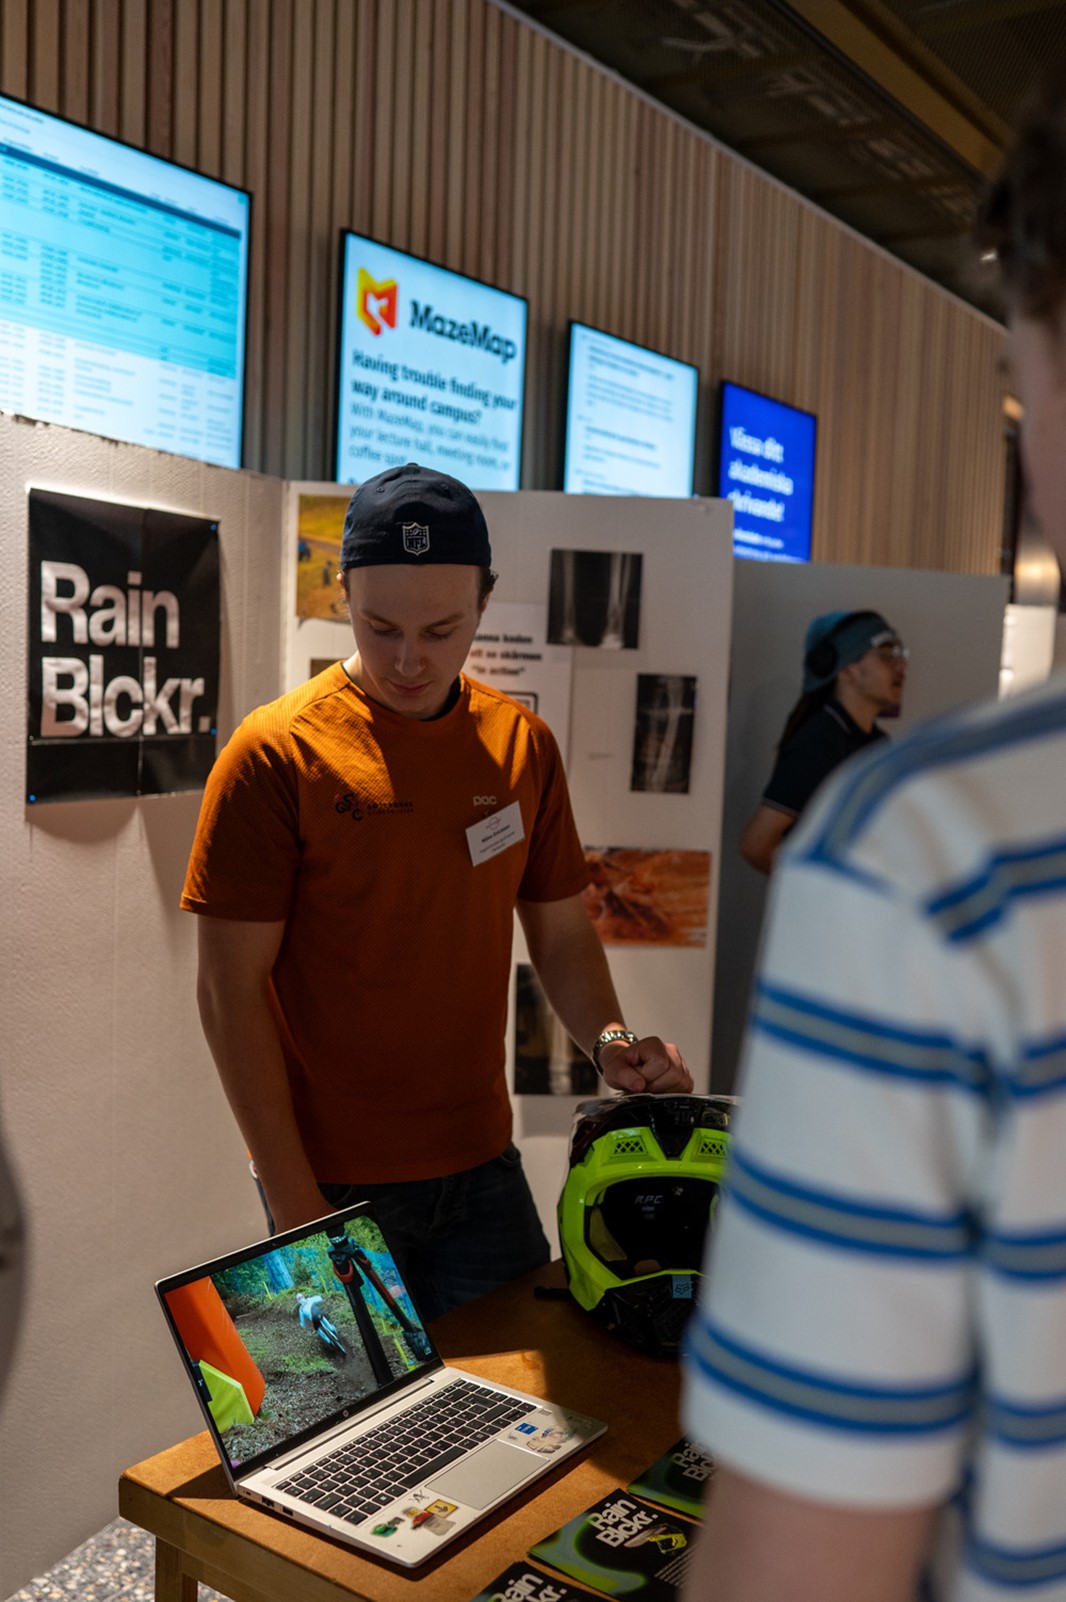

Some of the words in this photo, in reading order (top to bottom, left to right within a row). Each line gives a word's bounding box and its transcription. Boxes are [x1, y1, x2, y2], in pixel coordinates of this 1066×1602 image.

[410, 300, 517, 365] MazeMap
[351, 379, 378, 400] way
[382, 388, 427, 411] around
[430, 400, 483, 424] campus?
[352, 350, 398, 381] Having
[401, 365, 447, 390] trouble
[450, 376, 490, 406] finding
[492, 394, 516, 410] your
[40, 559, 180, 649] Rain
[39, 654, 211, 738] Blckr.
[671, 1442, 707, 1468] Rai
[585, 1499, 637, 1531] Rain
[595, 1510, 659, 1548] Blckr.
[488, 1573, 544, 1602] ain
